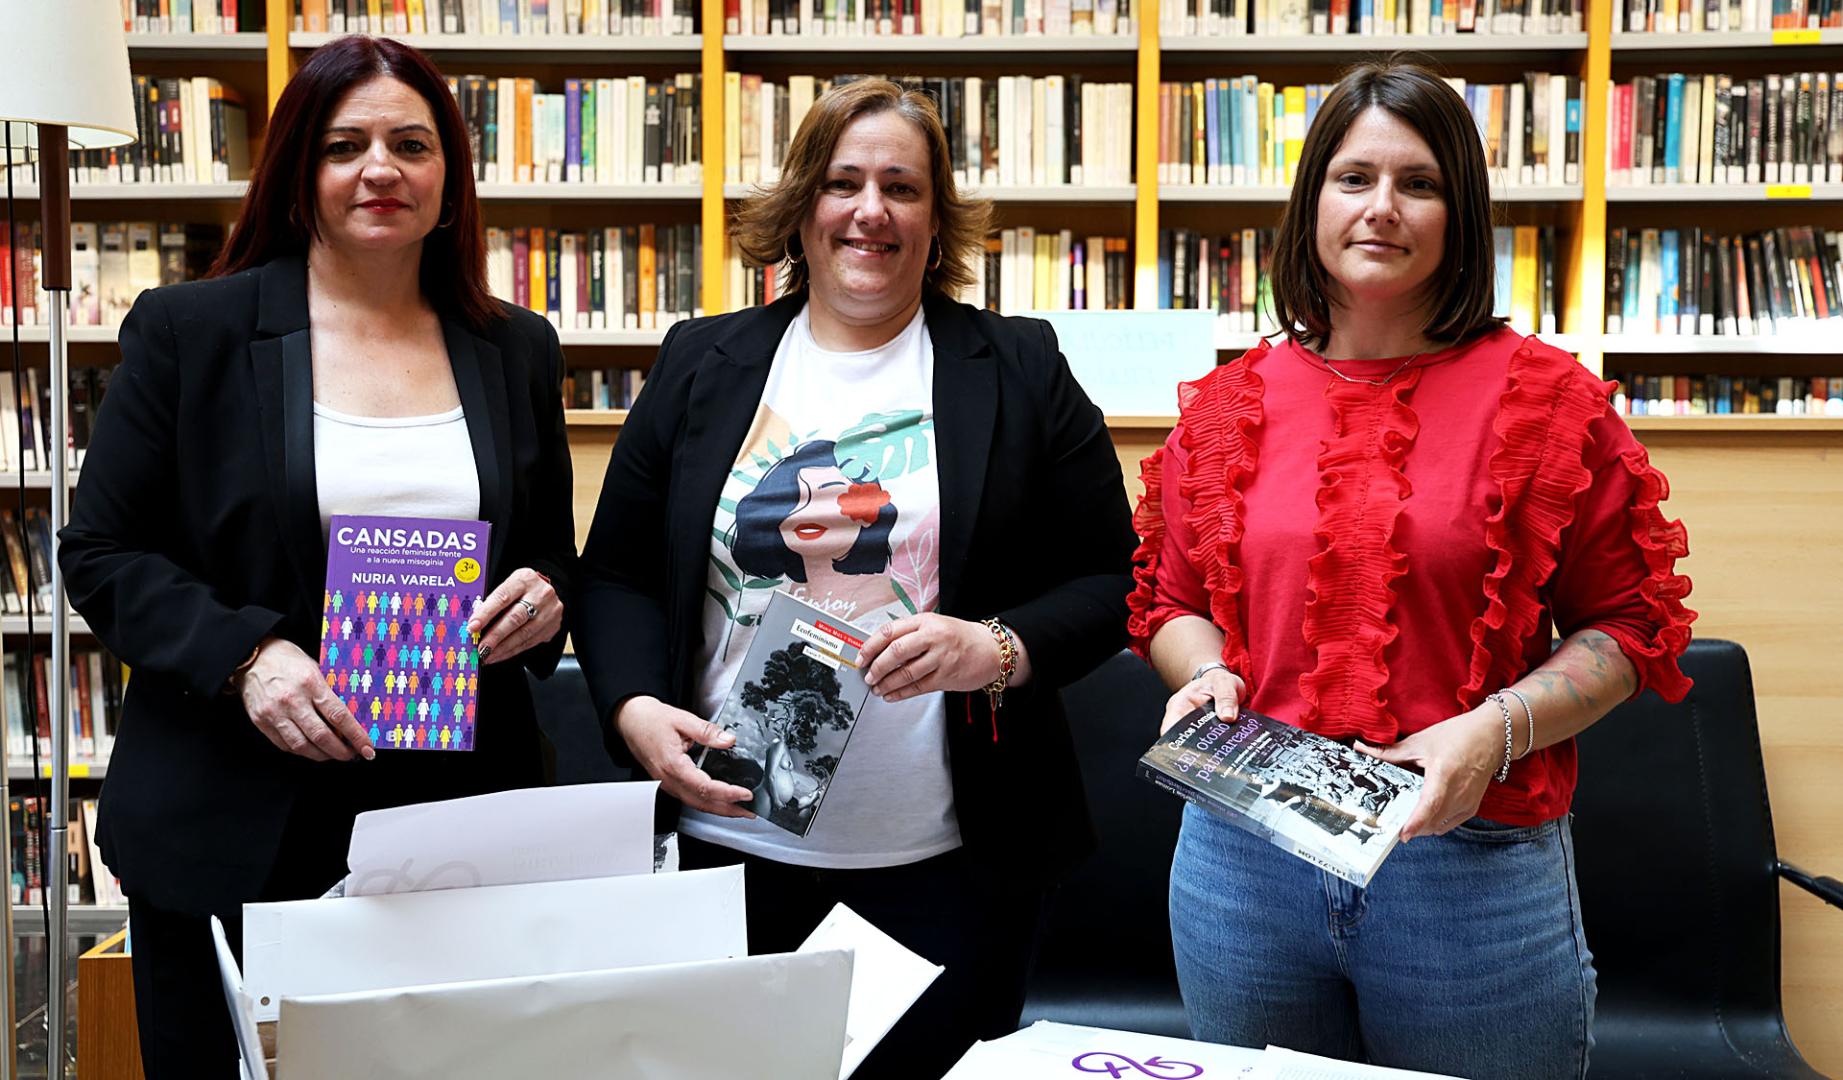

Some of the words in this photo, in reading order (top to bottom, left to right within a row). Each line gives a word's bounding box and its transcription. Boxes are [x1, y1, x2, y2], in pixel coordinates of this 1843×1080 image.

[337, 527, 477, 551] CANSADAS
[367, 547, 400, 555] reacción
[402, 548, 437, 557] feminista
[438, 550, 462, 558] frente
[406, 558, 444, 566] misoginia
[351, 572, 396, 585] NURIA
[401, 574, 456, 587] VARELA
[796, 624, 838, 649] Ecofeminismo
[1168, 728, 1197, 751] Carlos
[1174, 749, 1202, 773] ¿El
[1196, 722, 1231, 751] otoño
[1196, 718, 1263, 783] patriarcado?
